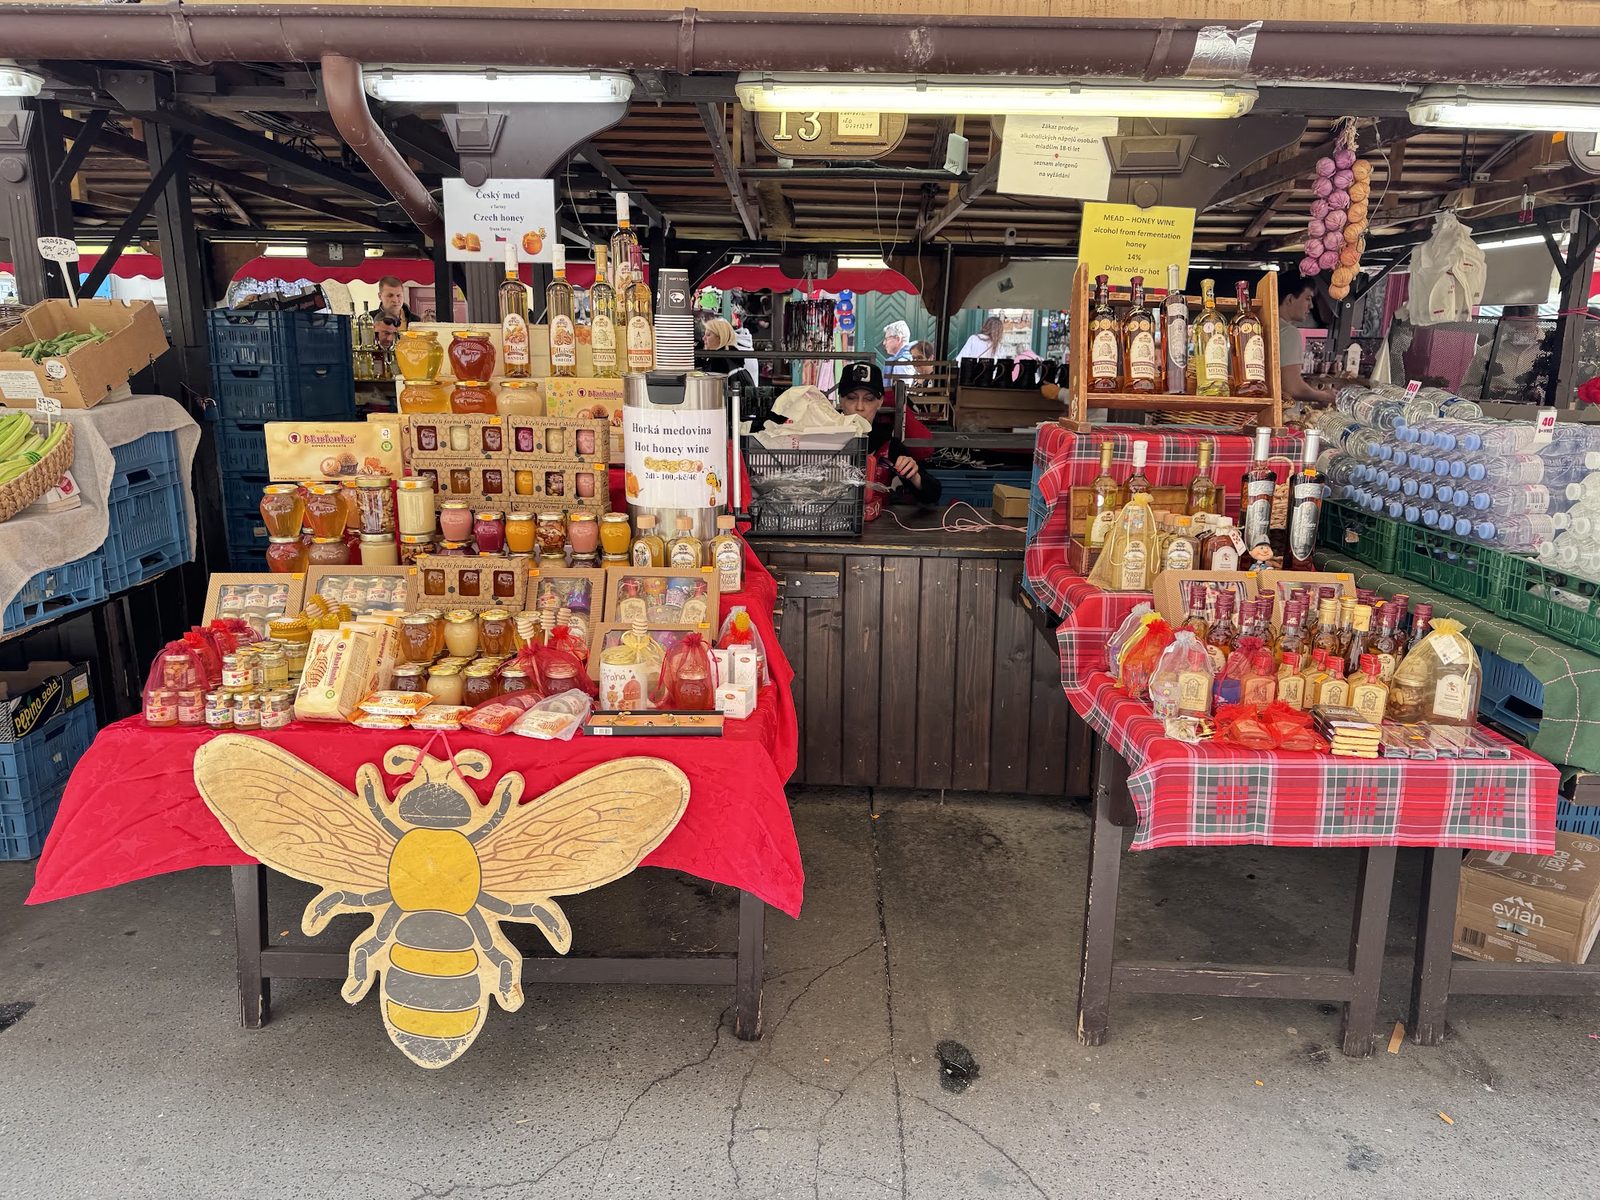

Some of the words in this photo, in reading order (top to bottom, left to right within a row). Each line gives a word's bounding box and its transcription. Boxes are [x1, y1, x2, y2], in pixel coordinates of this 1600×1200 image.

[773, 112, 823, 141] 13
[1020, 133, 1057, 142] alkoholických
[475, 189, 500, 201] Český
[502, 191, 521, 199] med
[473, 213, 498, 222] Czech
[500, 213, 525, 224] honey
[1103, 214, 1125, 222] MEAD
[1131, 217, 1156, 225] HONEY
[1156, 219, 1176, 227] WINE
[1093, 227, 1119, 235] alcohol
[1137, 230, 1181, 240] fermentation
[1125, 241, 1147, 249] honey
[1127, 253, 1142, 261] 14%
[1104, 264, 1122, 272] Drink
[1407, 382, 1419, 392] 80
[1541, 416, 1555, 427] 40
[632, 422, 660, 435] Horká
[662, 425, 712, 435] medovina
[634, 441, 650, 452] Hot
[652, 443, 684, 456] honey
[686, 444, 710, 454] wine
[645, 472, 656, 480] 2dl
[41, 679, 59, 702] gold
[1491, 902, 1545, 928] evian
